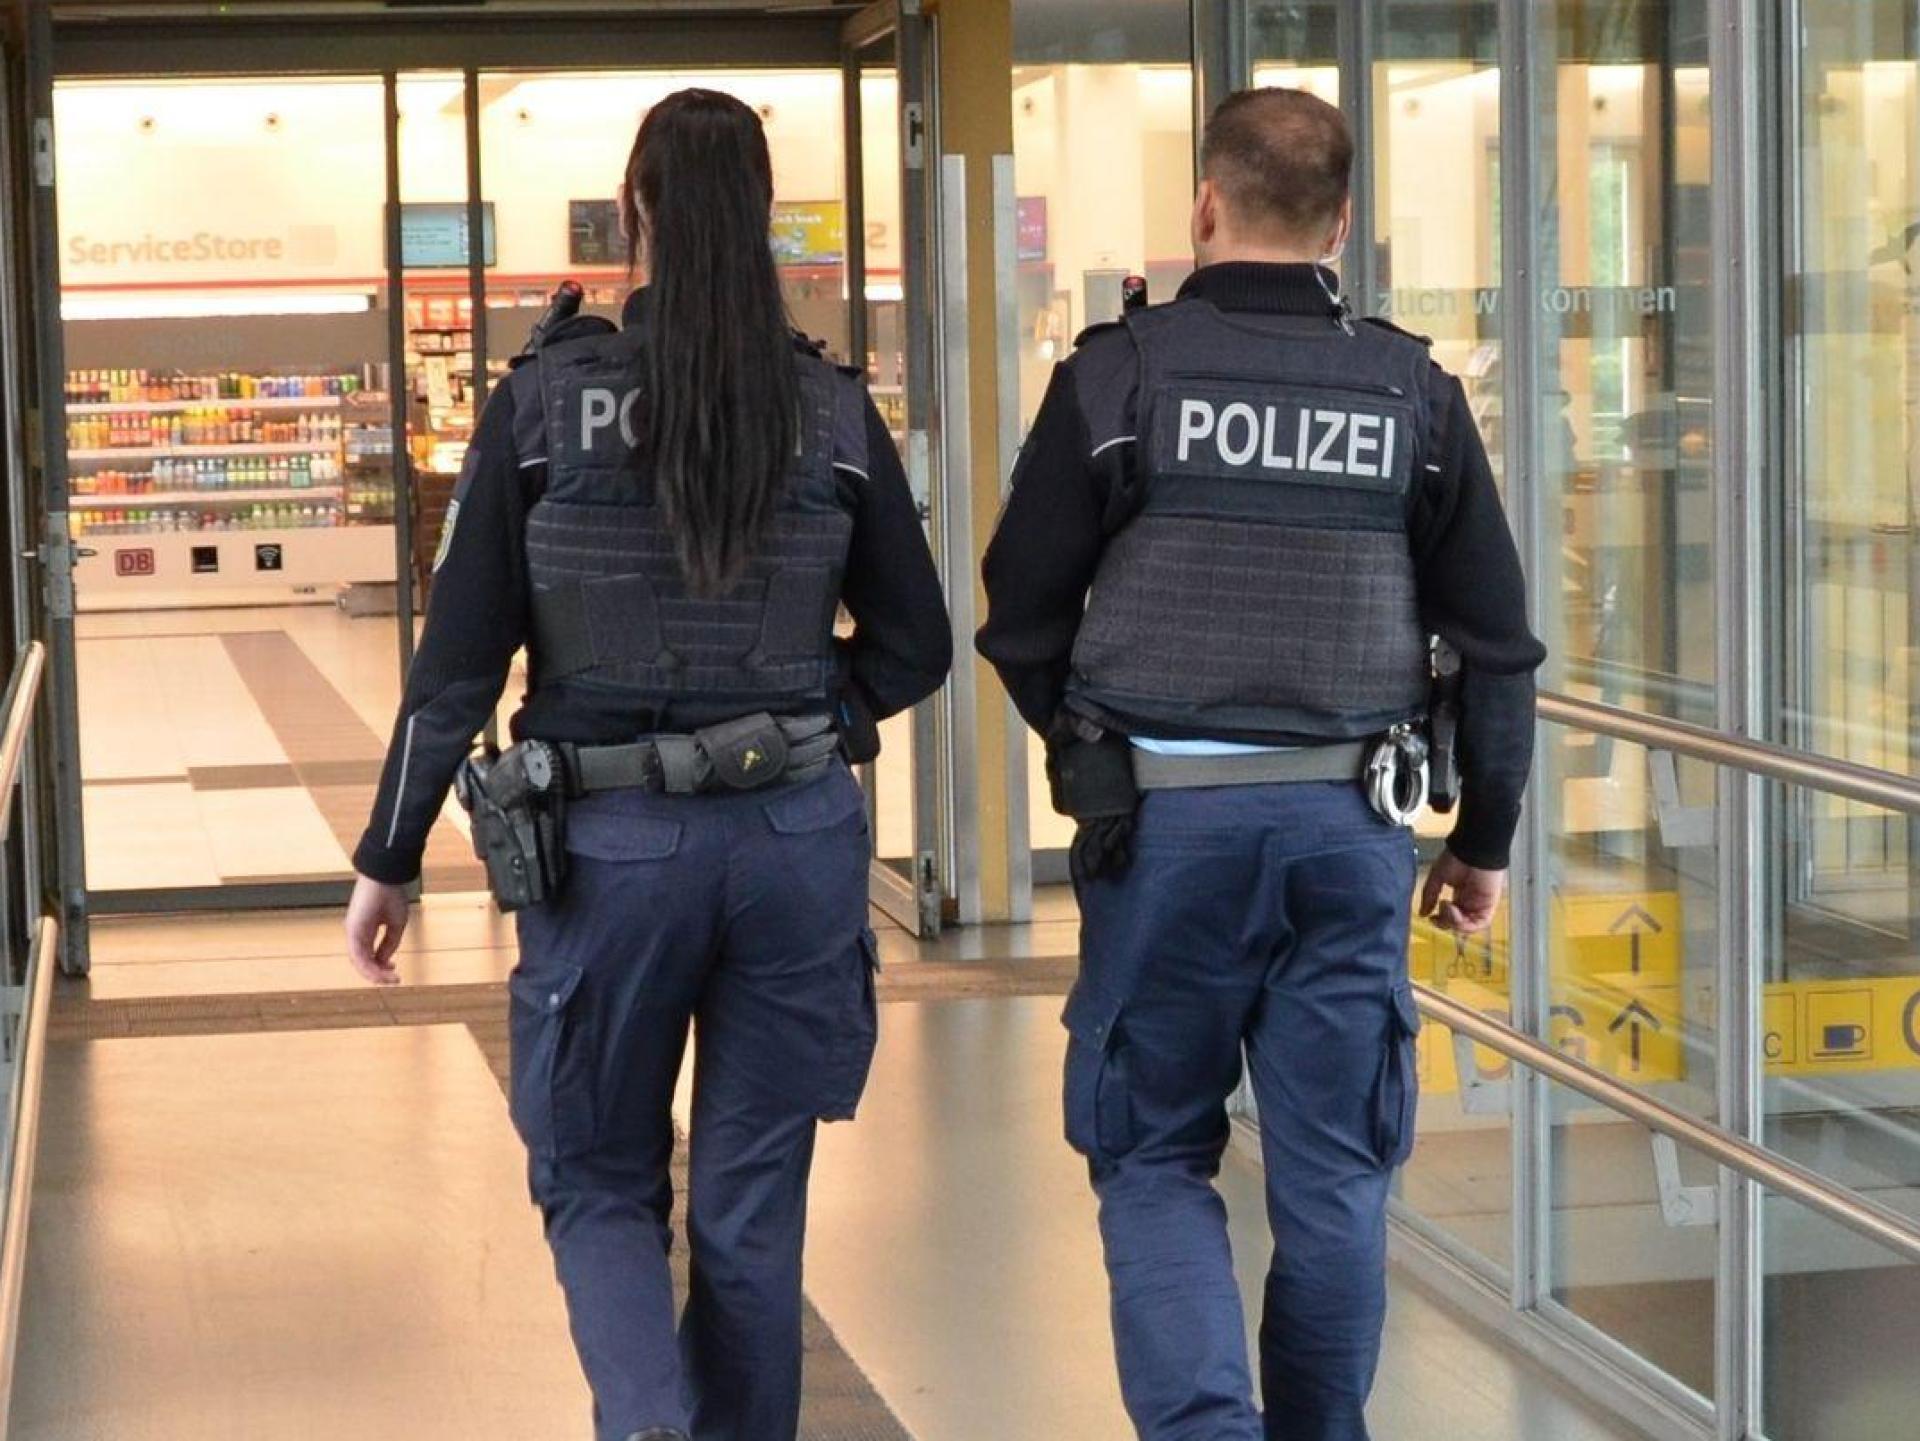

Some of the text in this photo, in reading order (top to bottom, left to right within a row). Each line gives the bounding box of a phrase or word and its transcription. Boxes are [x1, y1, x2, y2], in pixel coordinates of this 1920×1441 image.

[68, 232, 283, 265] ServiceStore
[1177, 399, 1395, 479] POLIZEI
[119, 552, 150, 572] DB
